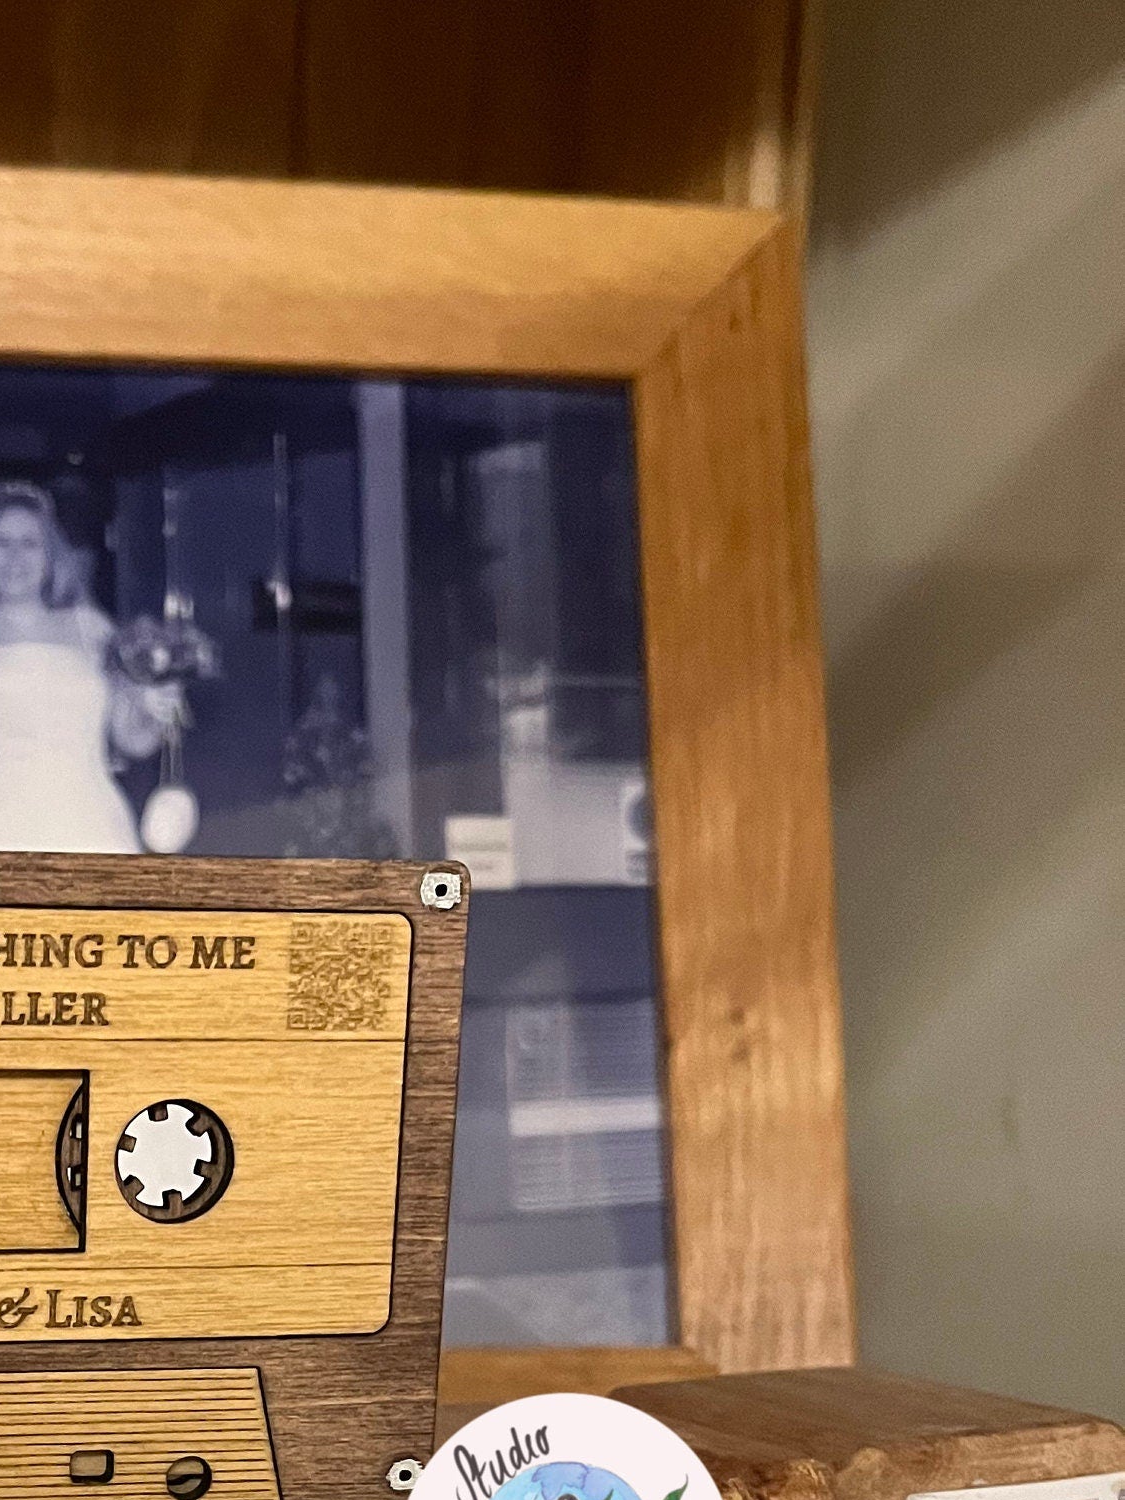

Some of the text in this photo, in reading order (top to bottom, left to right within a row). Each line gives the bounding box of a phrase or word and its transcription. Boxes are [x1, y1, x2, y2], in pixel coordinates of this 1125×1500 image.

[117, 934, 178, 970] TO
[189, 935, 257, 970] ME
[45, 1288, 143, 1329] LISA
